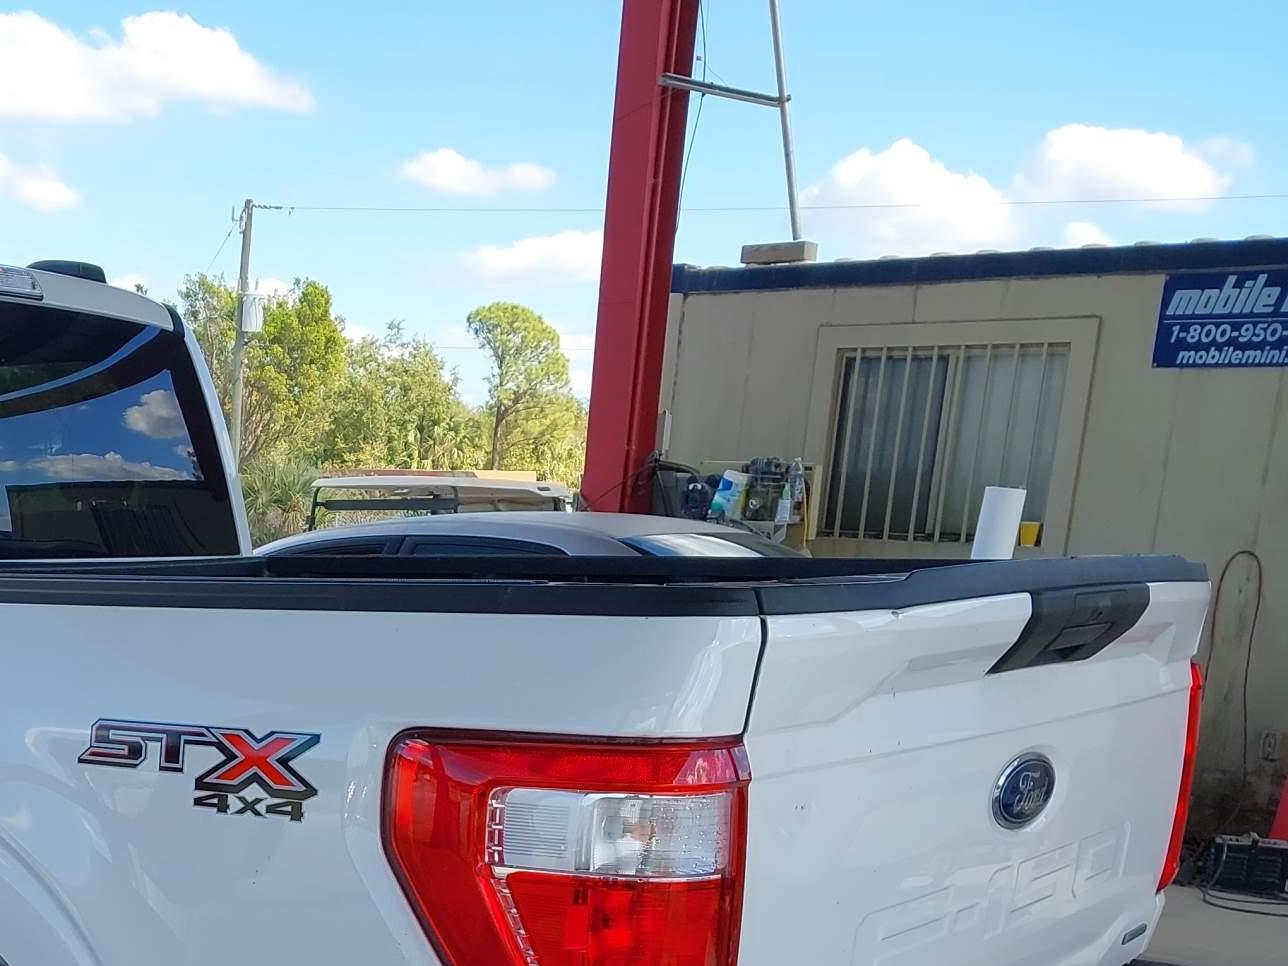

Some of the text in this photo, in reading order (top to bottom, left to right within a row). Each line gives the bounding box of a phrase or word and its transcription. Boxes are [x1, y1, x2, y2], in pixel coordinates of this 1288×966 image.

[1166, 273, 1281, 315] mobile
[1170, 323, 1288, 343] 1-800-950-
[77, 718, 321, 800] STX
